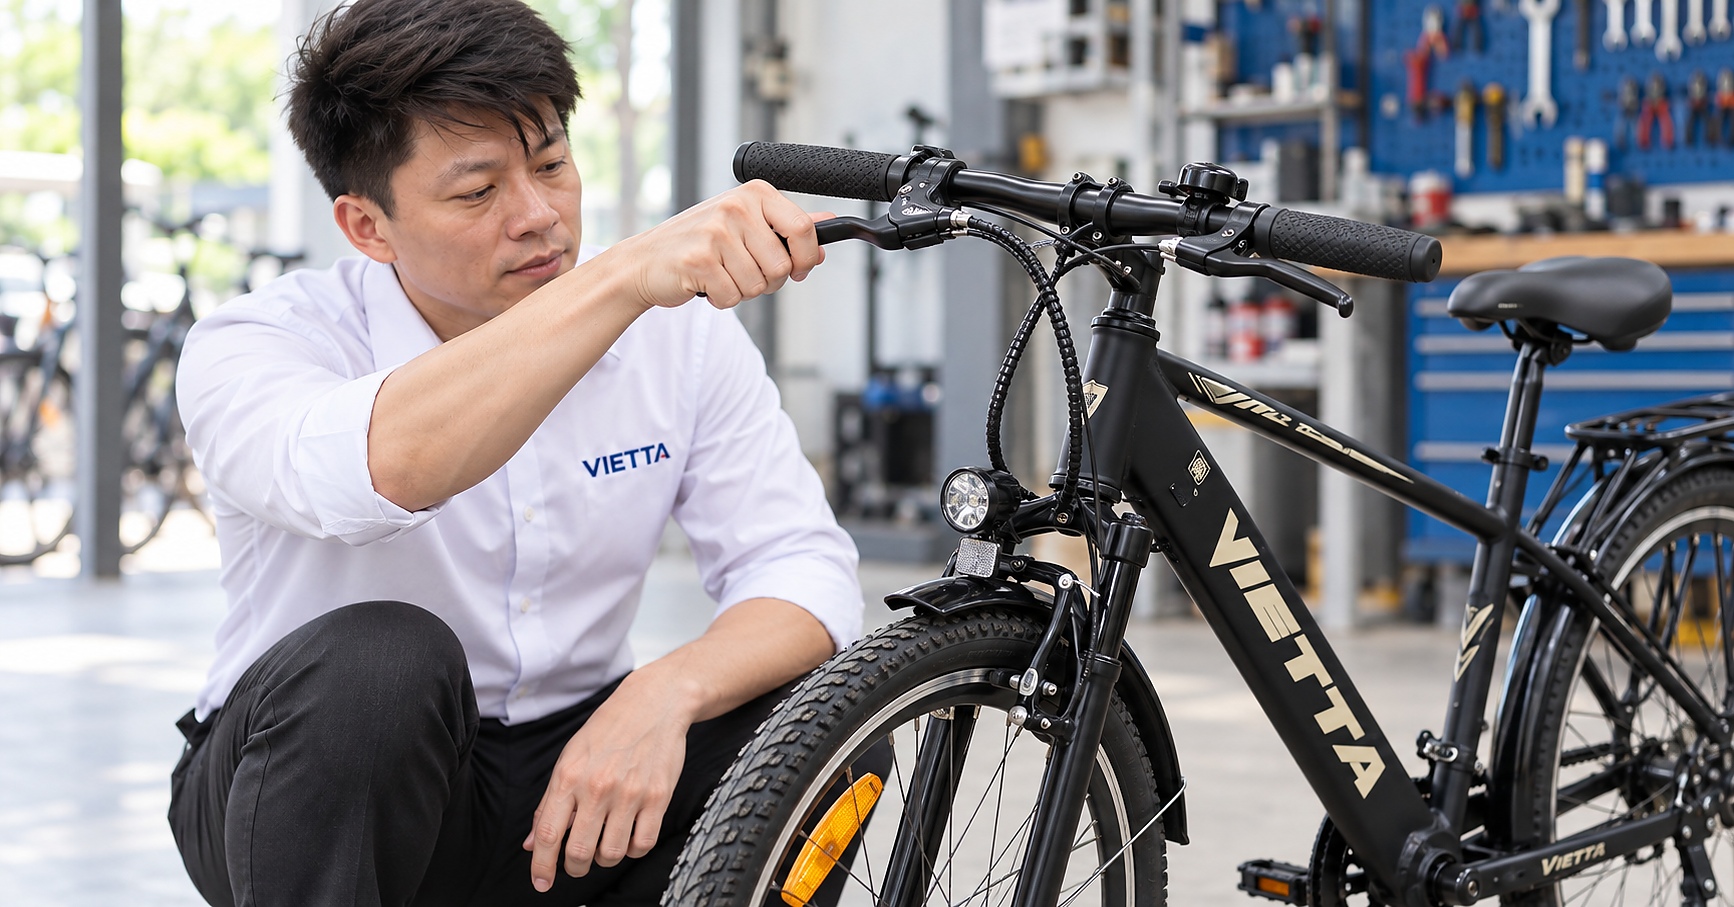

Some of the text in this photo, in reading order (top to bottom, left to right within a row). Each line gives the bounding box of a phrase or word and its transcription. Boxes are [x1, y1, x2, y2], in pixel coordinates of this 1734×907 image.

[582, 442, 671, 478] VIETTA
[1208, 507, 1387, 800] VIETTA
[1541, 841, 1606, 877] VIETTA
